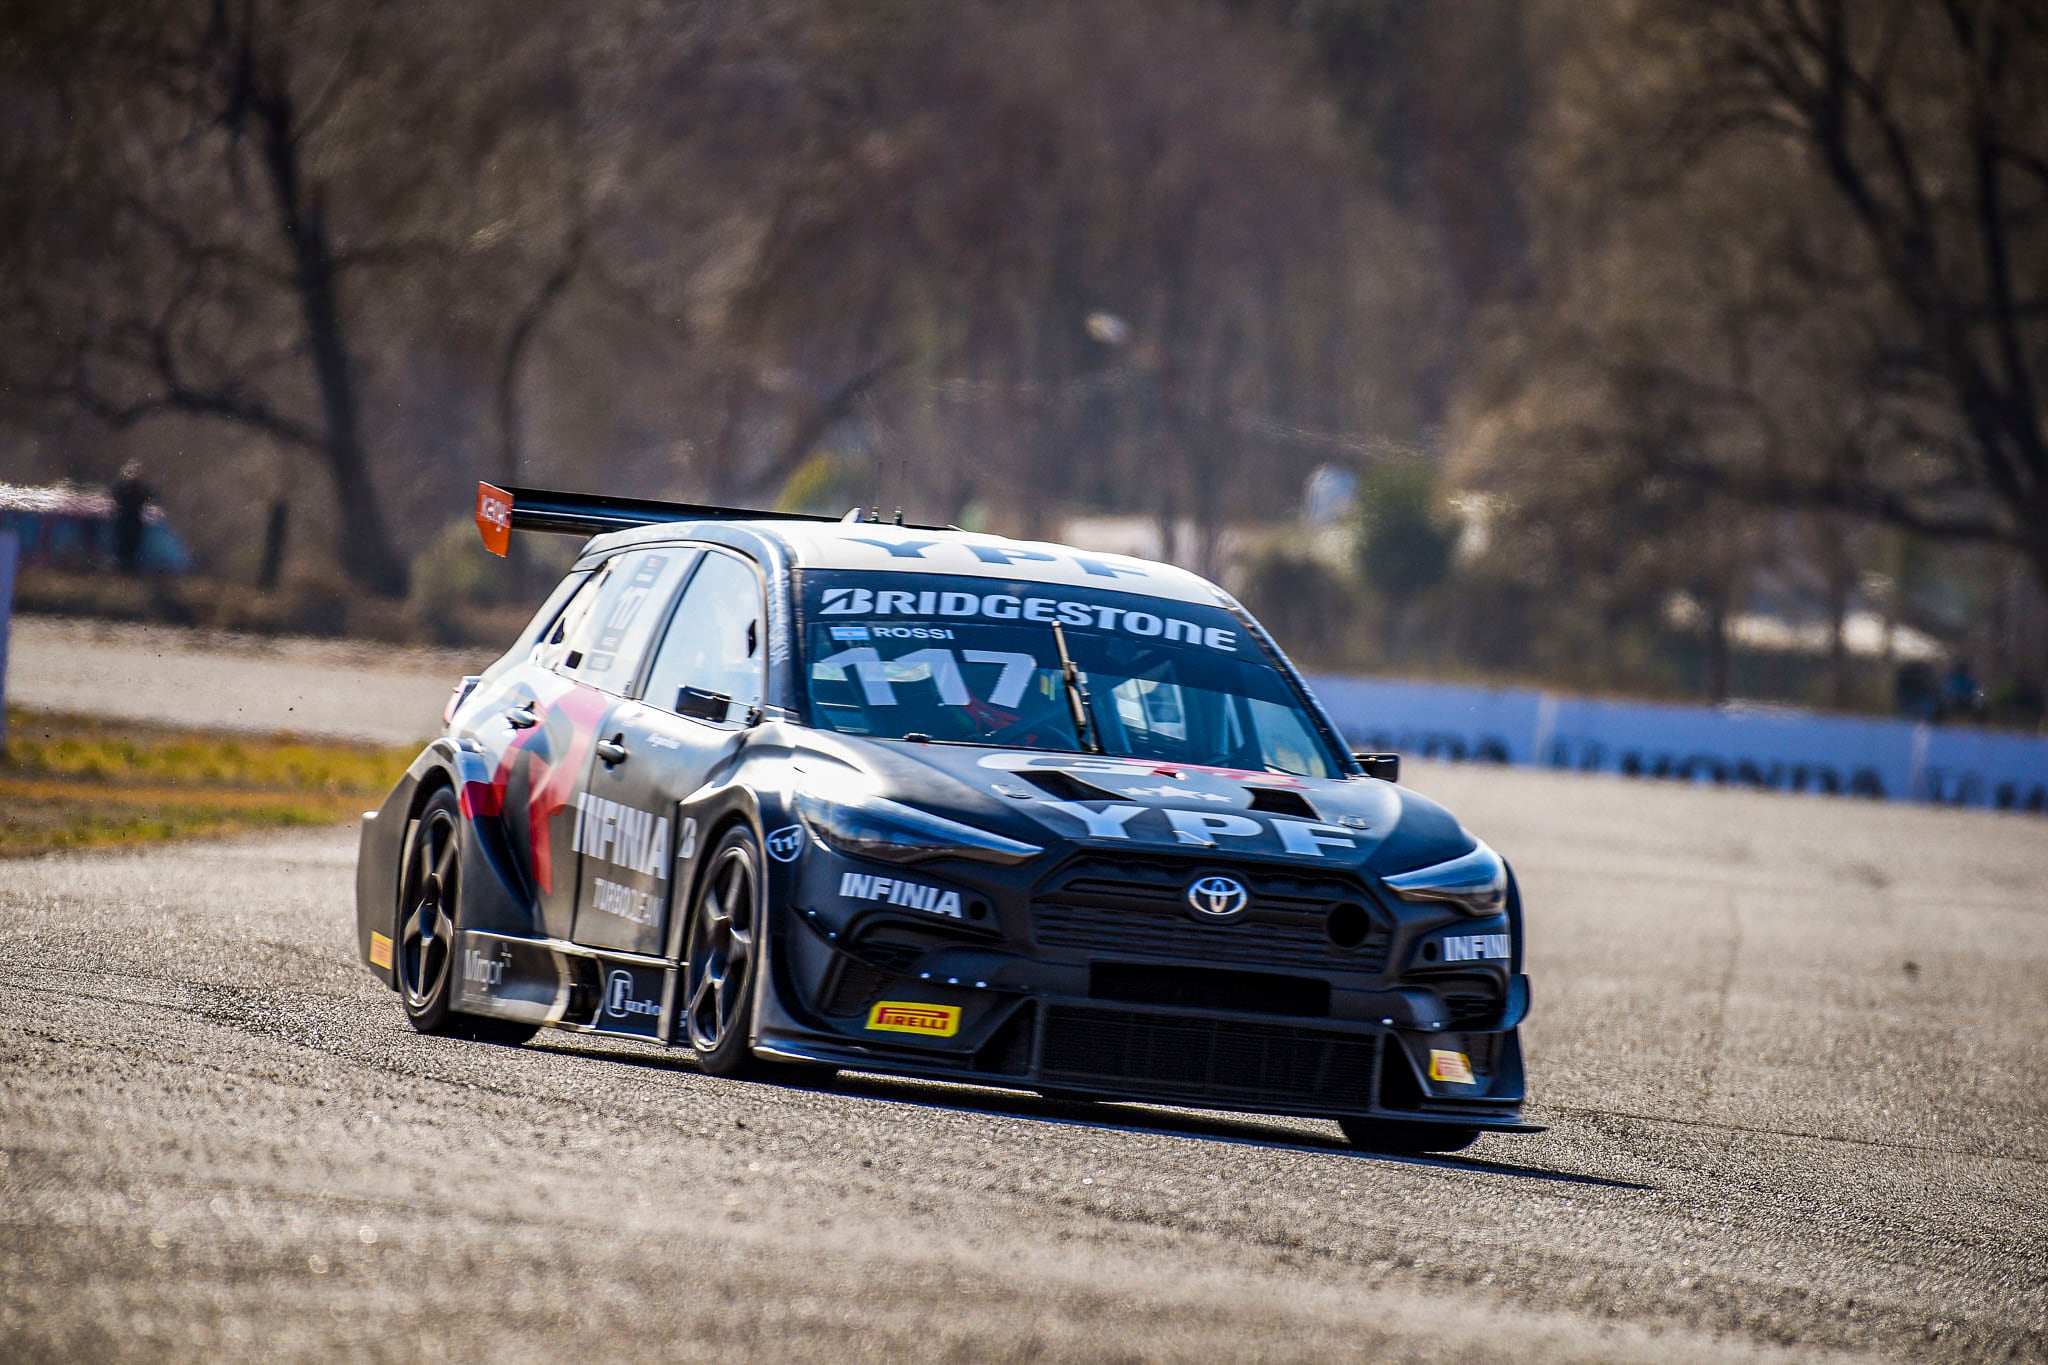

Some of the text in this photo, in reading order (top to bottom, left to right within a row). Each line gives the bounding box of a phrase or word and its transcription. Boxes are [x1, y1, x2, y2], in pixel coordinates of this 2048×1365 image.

[838, 536, 1152, 579] YPF
[818, 587, 1240, 653] BRIDGESTONE
[871, 626, 956, 641] ROSSI
[817, 646, 1038, 710] 117
[571, 791, 669, 880] INFINIA
[1035, 800, 1358, 857] YPF
[838, 872, 963, 919] INFINIA
[876, 1006, 951, 1031] PIRELLI
